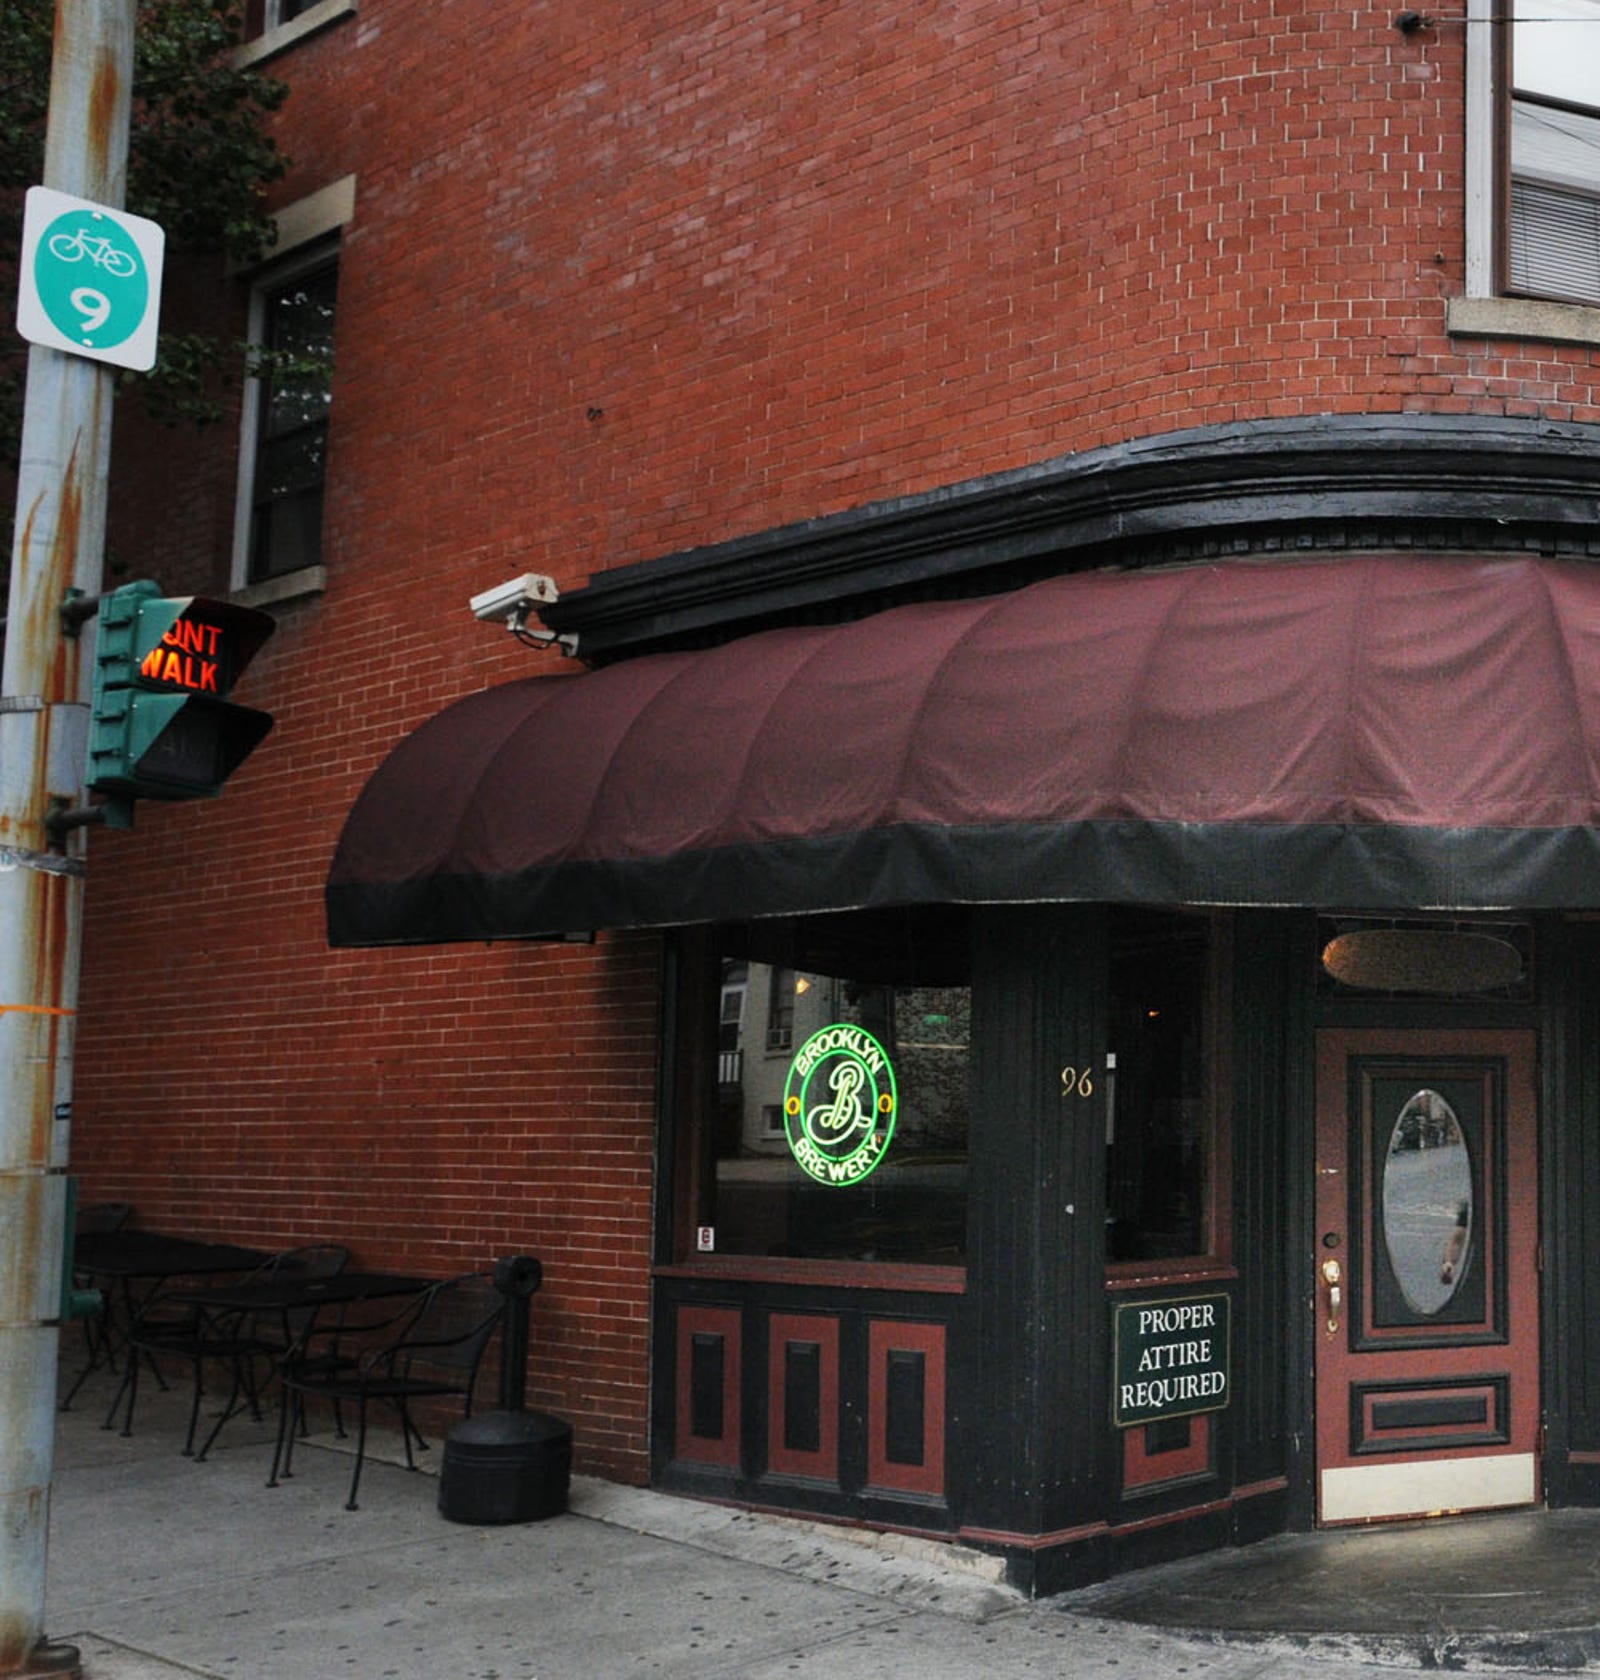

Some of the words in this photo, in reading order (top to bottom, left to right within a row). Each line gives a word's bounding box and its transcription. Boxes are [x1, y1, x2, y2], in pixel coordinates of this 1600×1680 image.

[70, 287, 112, 332] 9
[163, 618, 223, 656] ONT
[141, 648, 218, 692] WALK
[795, 1029, 885, 1076] BROOKLYN
[1061, 1066, 1093, 1098] 96
[794, 1134, 881, 1181] BREWERY
[1139, 1304, 1215, 1334] PROPER
[1138, 1339, 1213, 1372] ATTIRE
[1121, 1371, 1226, 1409] REQUIRED
